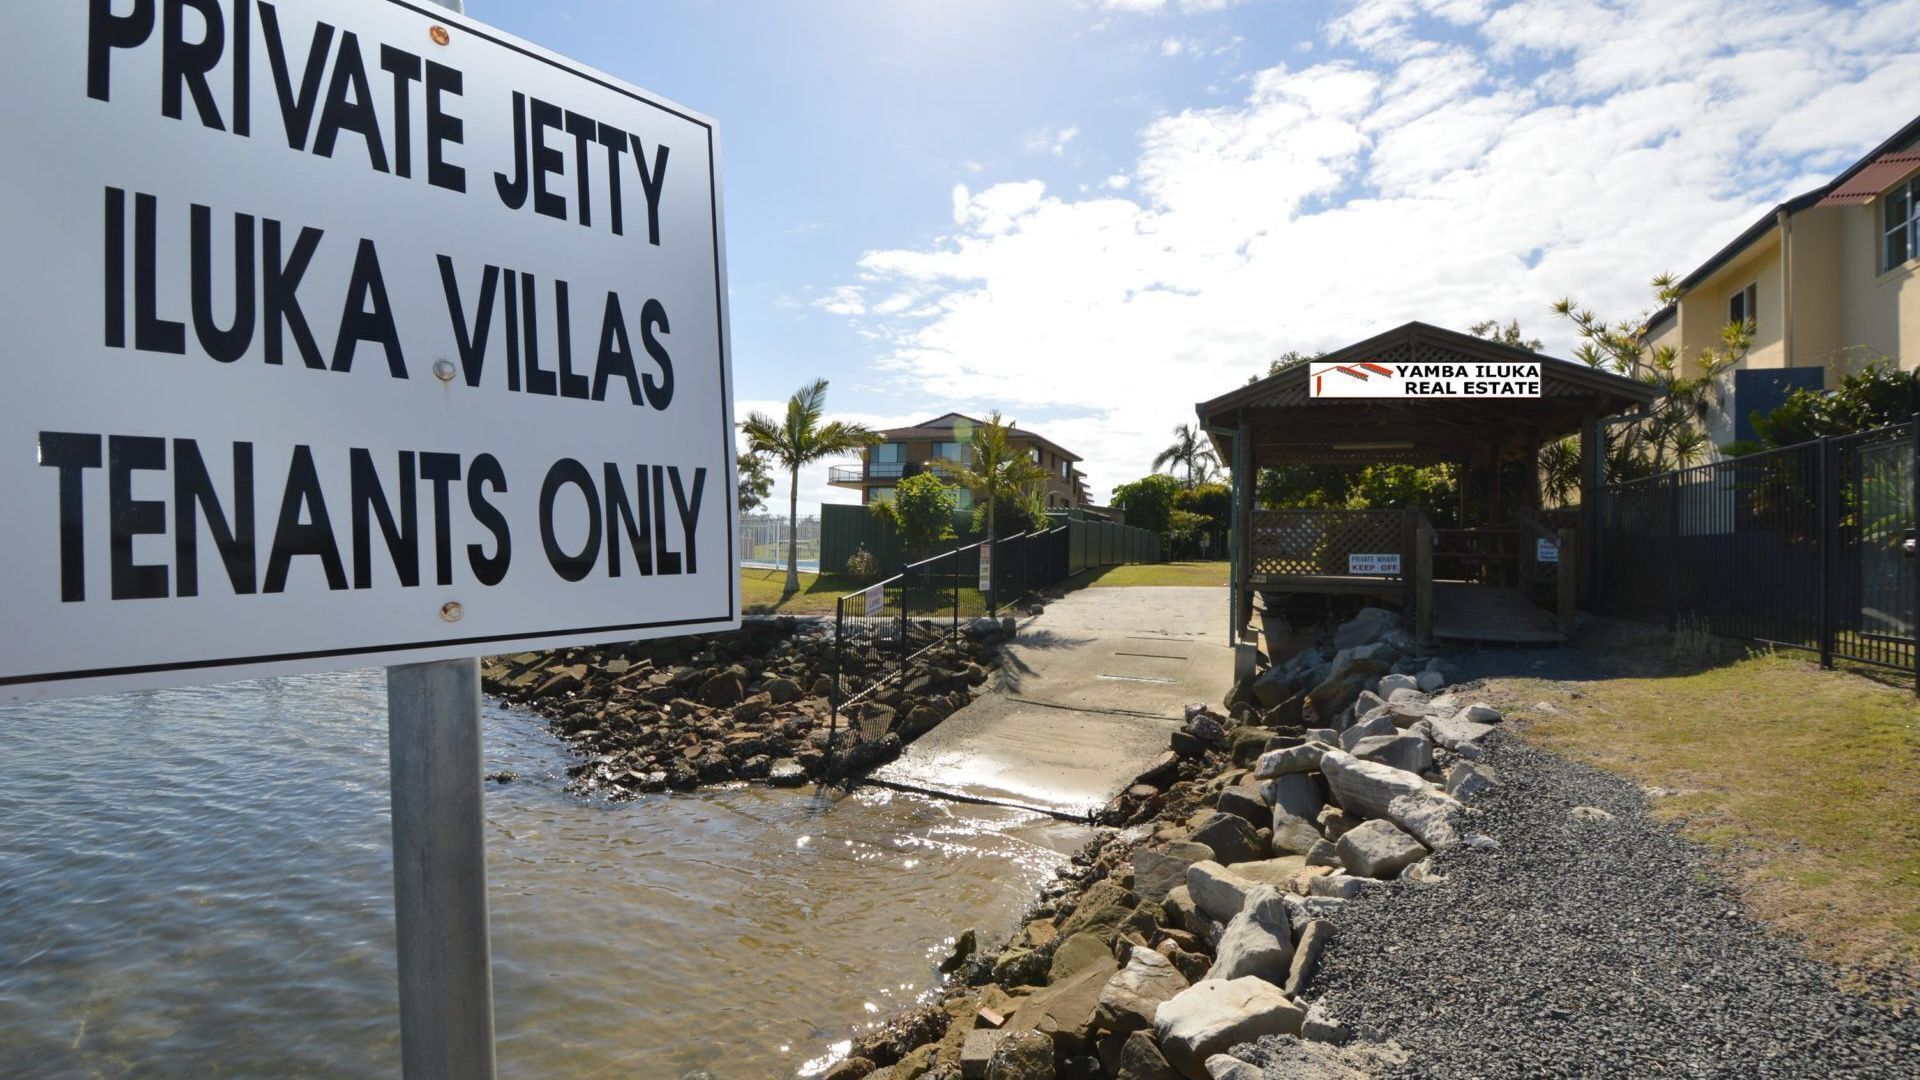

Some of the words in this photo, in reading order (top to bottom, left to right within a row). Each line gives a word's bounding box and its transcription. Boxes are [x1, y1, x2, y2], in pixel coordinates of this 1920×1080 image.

[87, 0, 466, 194] PRIVATE
[494, 91, 670, 246] JETTY
[105, 186, 409, 379] ILUKA
[436, 254, 674, 411] VILLAS
[38, 431, 512, 603] TENANTS
[539, 458, 707, 583] ONLY
